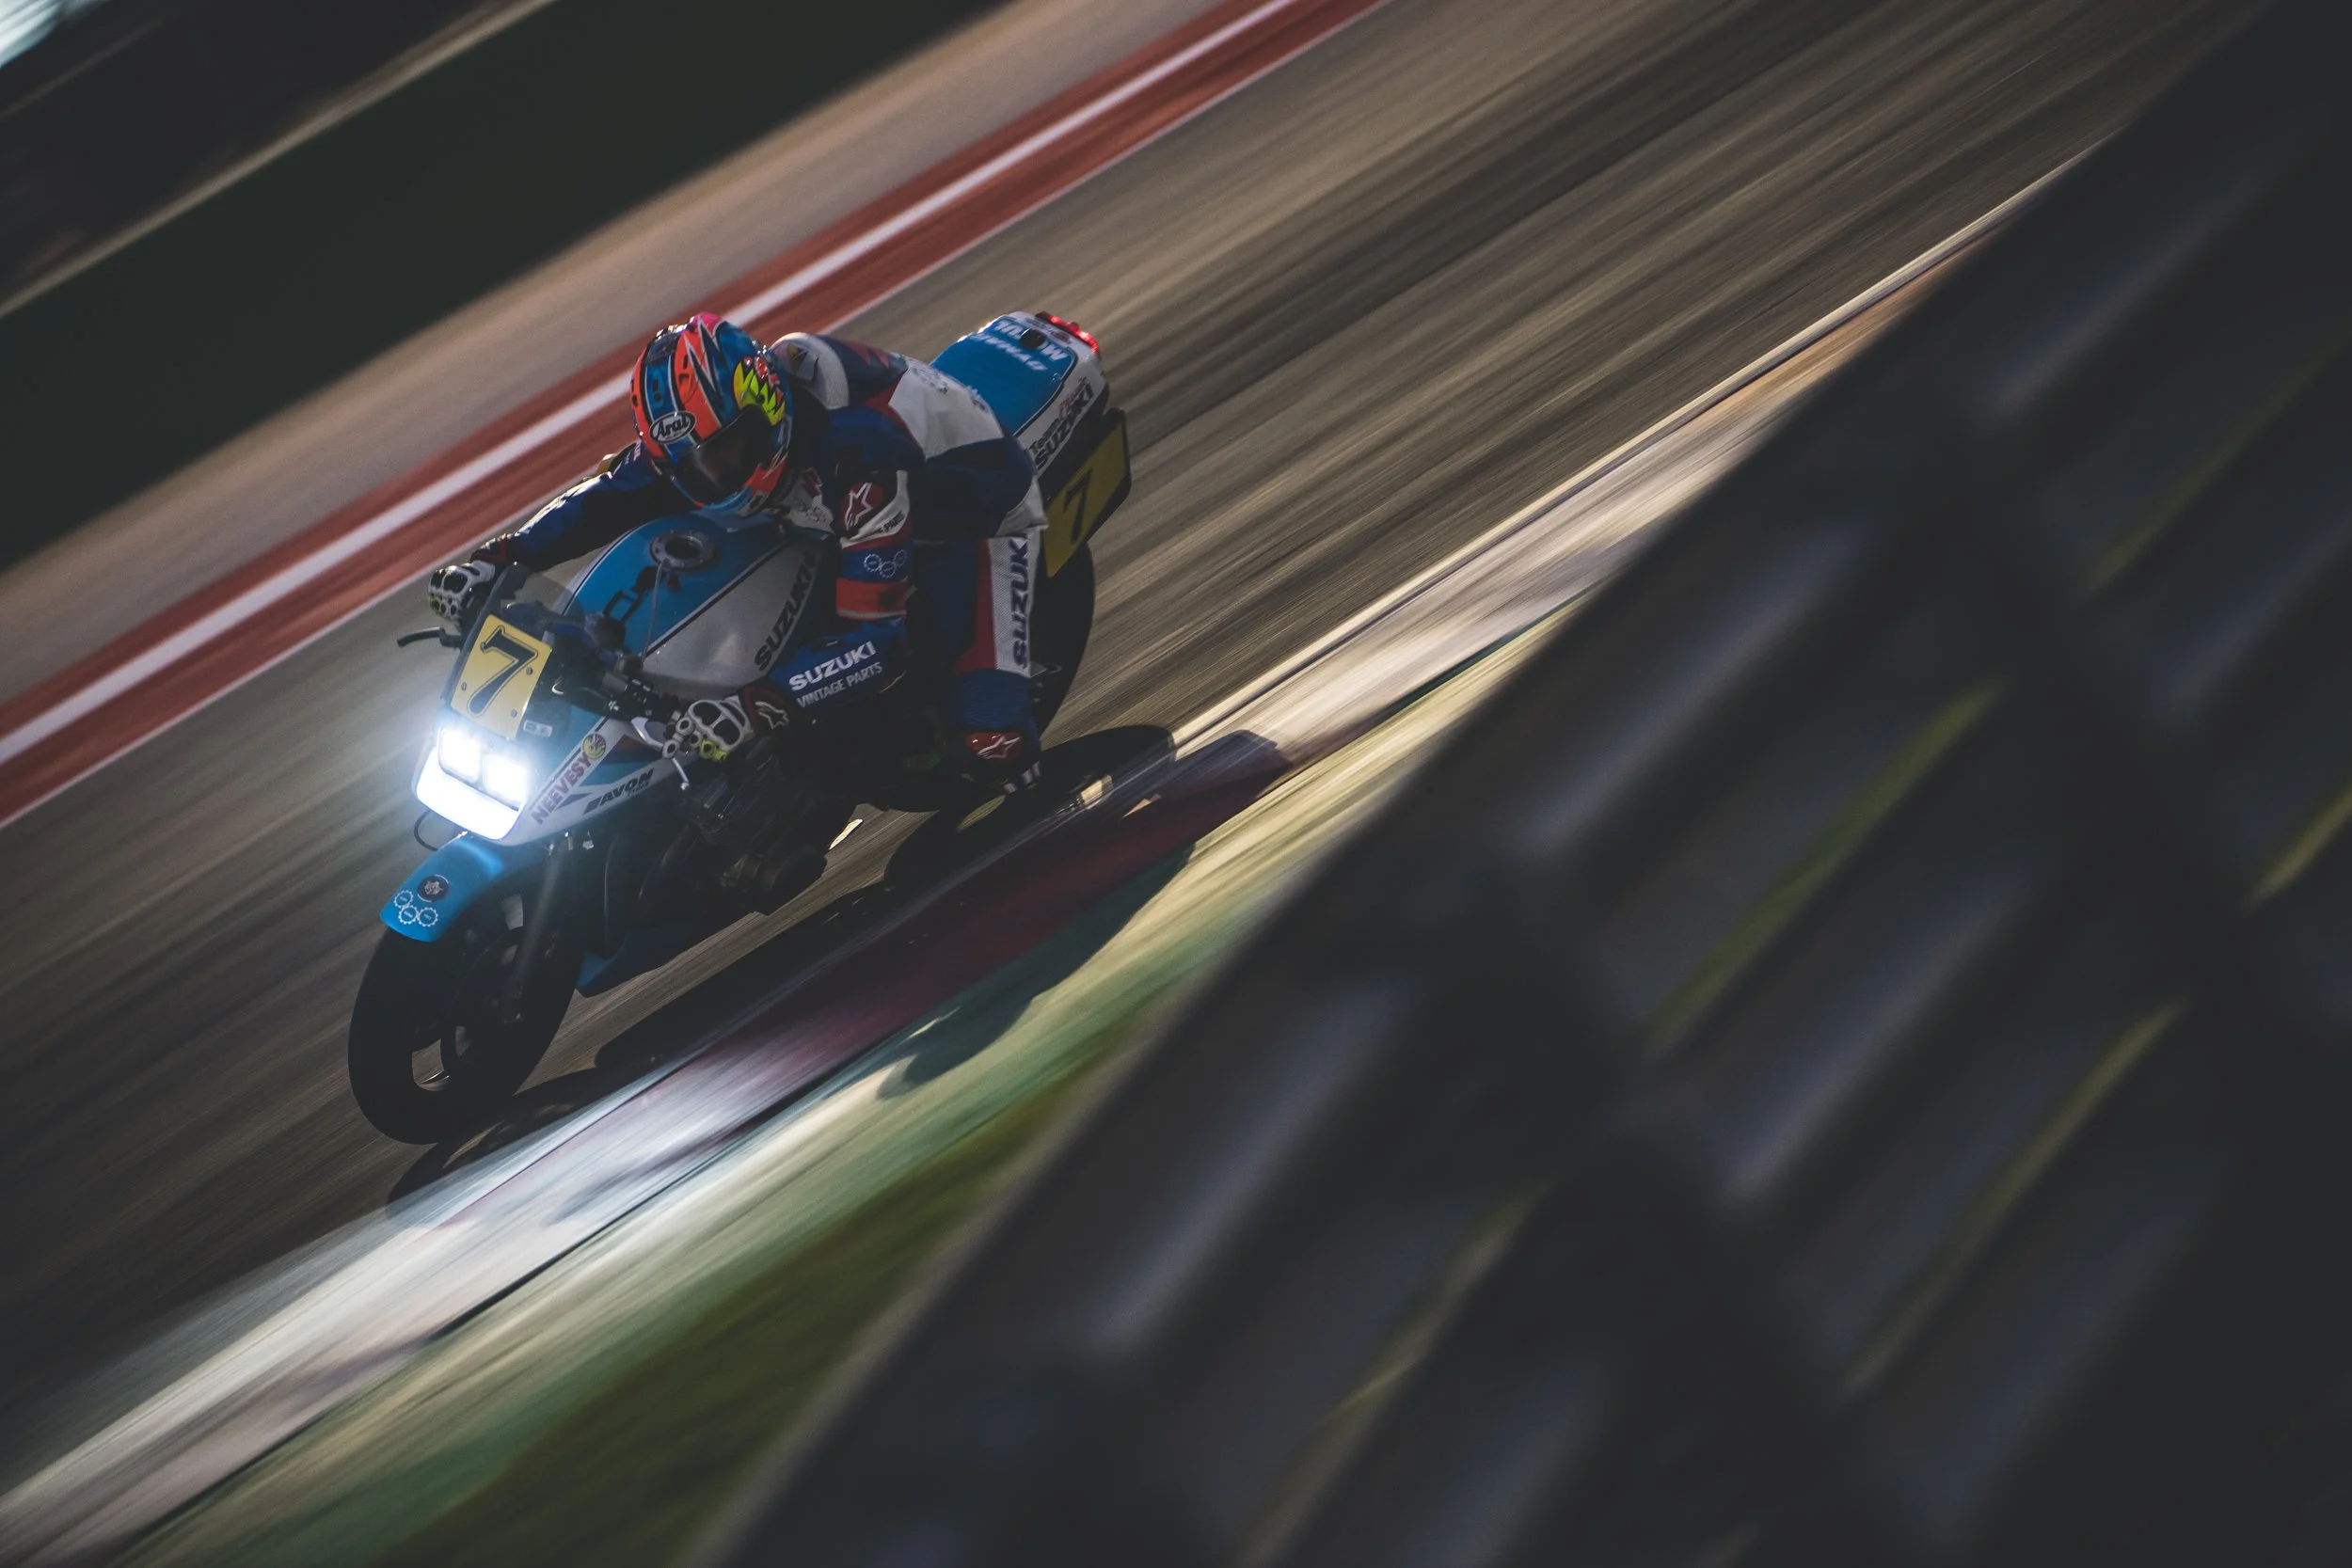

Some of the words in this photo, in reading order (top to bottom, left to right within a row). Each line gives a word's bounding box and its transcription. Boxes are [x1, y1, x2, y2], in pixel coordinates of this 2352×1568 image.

[993, 319, 1069, 361] MTUL
[1035, 383, 1094, 470] SUZUKI
[1062, 467, 1093, 546] 7
[755, 550, 817, 672] SUZUKI
[1009, 537, 1030, 670] SUZUK
[468, 625, 539, 717] 7
[788, 641, 877, 692] SUZUKI
[796, 677, 847, 708] VINTAGE
[846, 661, 883, 687] PARTS
[530, 752, 592, 825] NEEVESY
[599, 768, 655, 806] AVON
